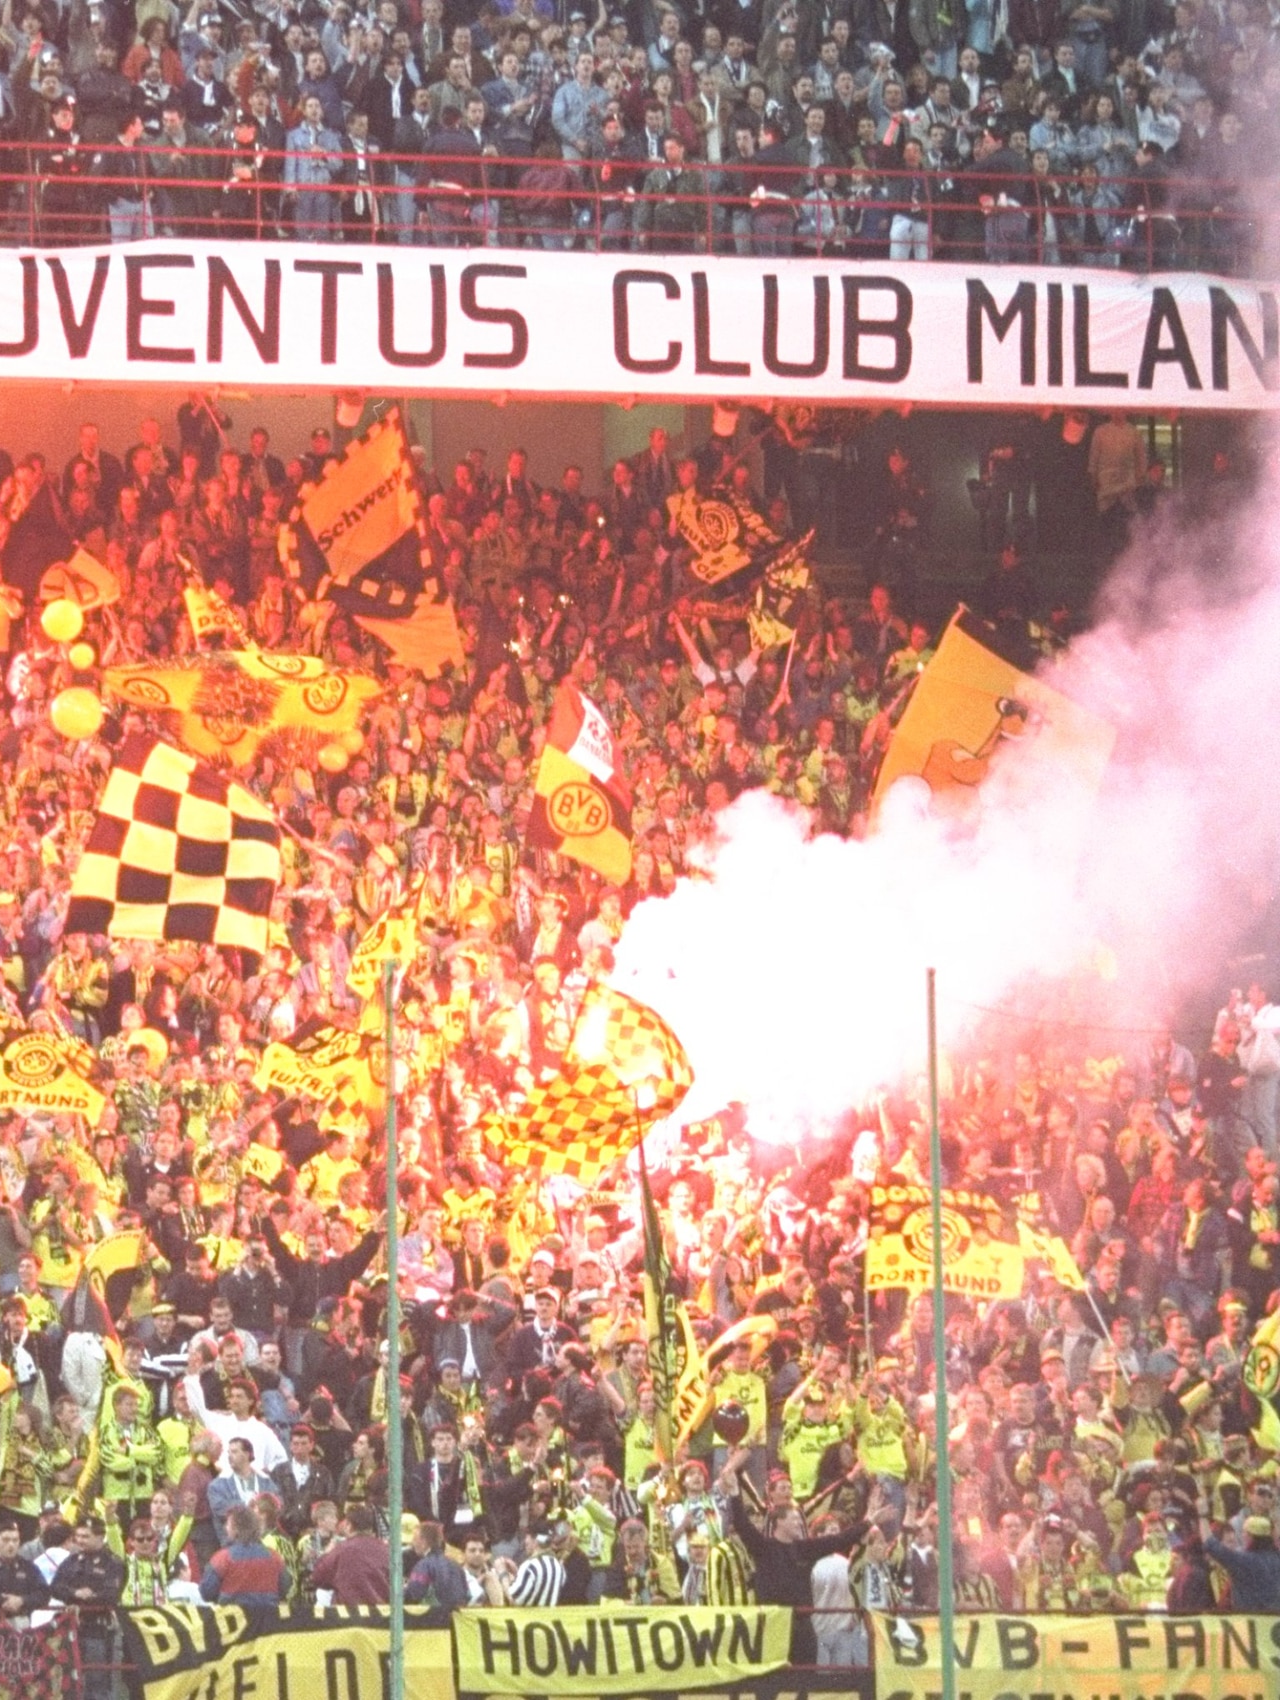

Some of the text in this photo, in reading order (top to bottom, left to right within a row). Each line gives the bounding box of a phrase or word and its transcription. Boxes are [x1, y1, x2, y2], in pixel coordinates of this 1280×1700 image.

[612, 268, 913, 385] CLUB
[558, 789, 603, 827] BVB
[870, 1186, 1001, 1213] BORSSIA
[128, 1604, 248, 1666] BVB
[479, 1613, 767, 1677] HOWITOWN
[884, 1619, 1040, 1670] BVB
